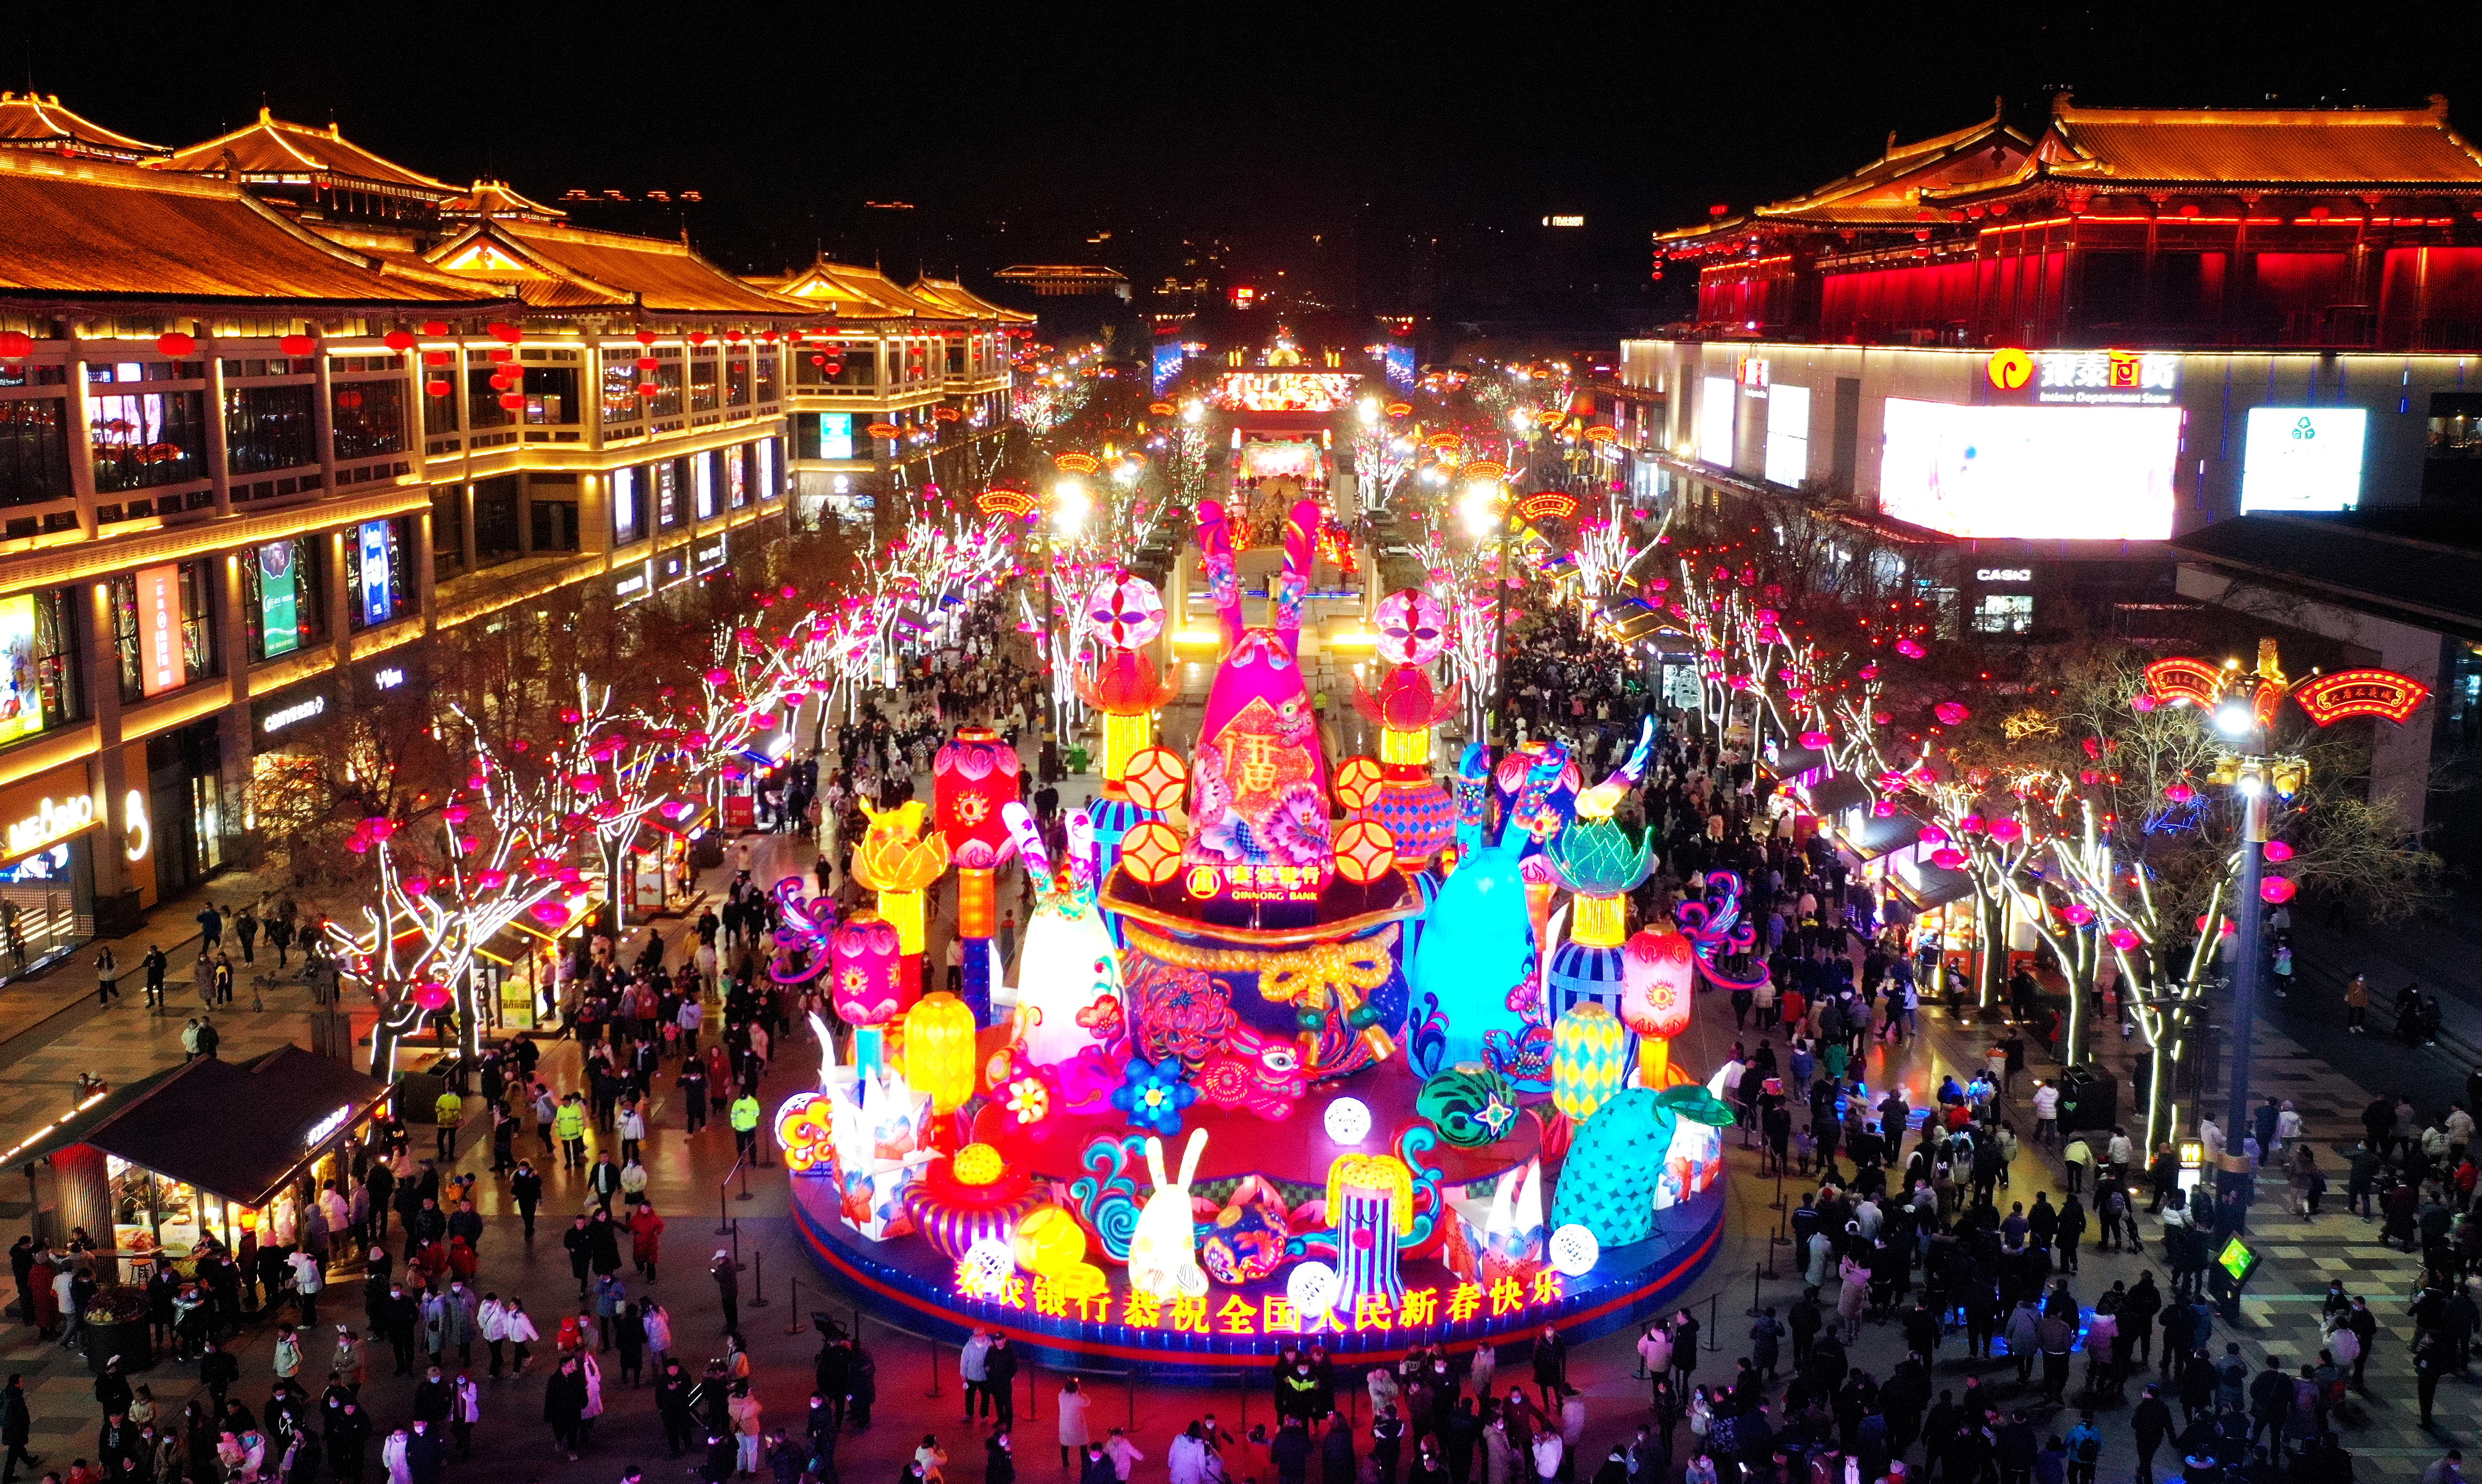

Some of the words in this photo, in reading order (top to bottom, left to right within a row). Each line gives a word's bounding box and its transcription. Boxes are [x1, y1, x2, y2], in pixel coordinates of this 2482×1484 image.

[2040, 392, 2074, 402] Intime
[2076, 392, 2140, 404] Department
[2331, 687, 2392, 703] 大唐不夜城
[1231, 890, 1285, 900] QINNONG
[1289, 891, 1317, 900] BANK
